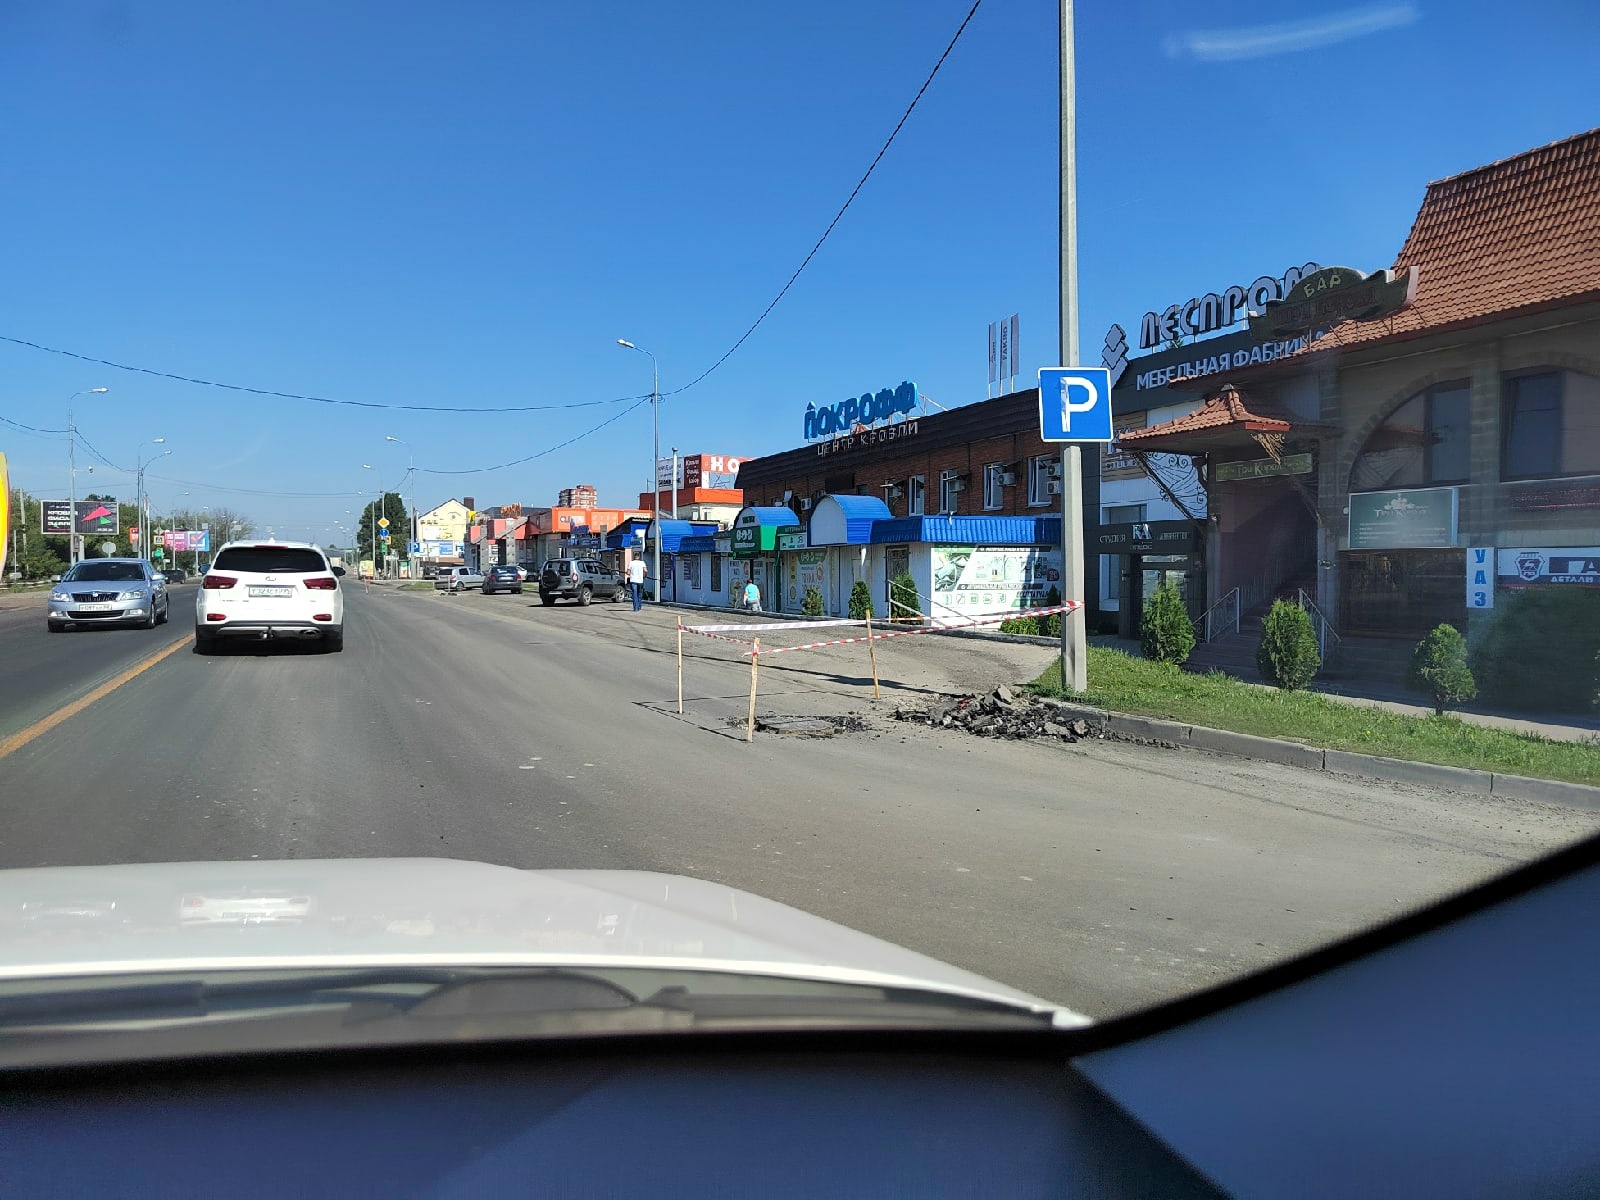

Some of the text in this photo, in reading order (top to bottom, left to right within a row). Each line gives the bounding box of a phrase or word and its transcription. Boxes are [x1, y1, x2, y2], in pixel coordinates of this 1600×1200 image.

[1304, 274, 1342, 297] БАР
[1136, 350, 1231, 391] МЕБЕЛЬНАЯ
[803, 380, 918, 439] ПОКРОФФ
[1060, 376, 1098, 432] P
[817, 421, 919, 457] ЦЕНТР КРОВЛИ
[1474, 549, 1487, 607] УАЗ
[1551, 575, 1594, 583] ДЕТАЛИ
